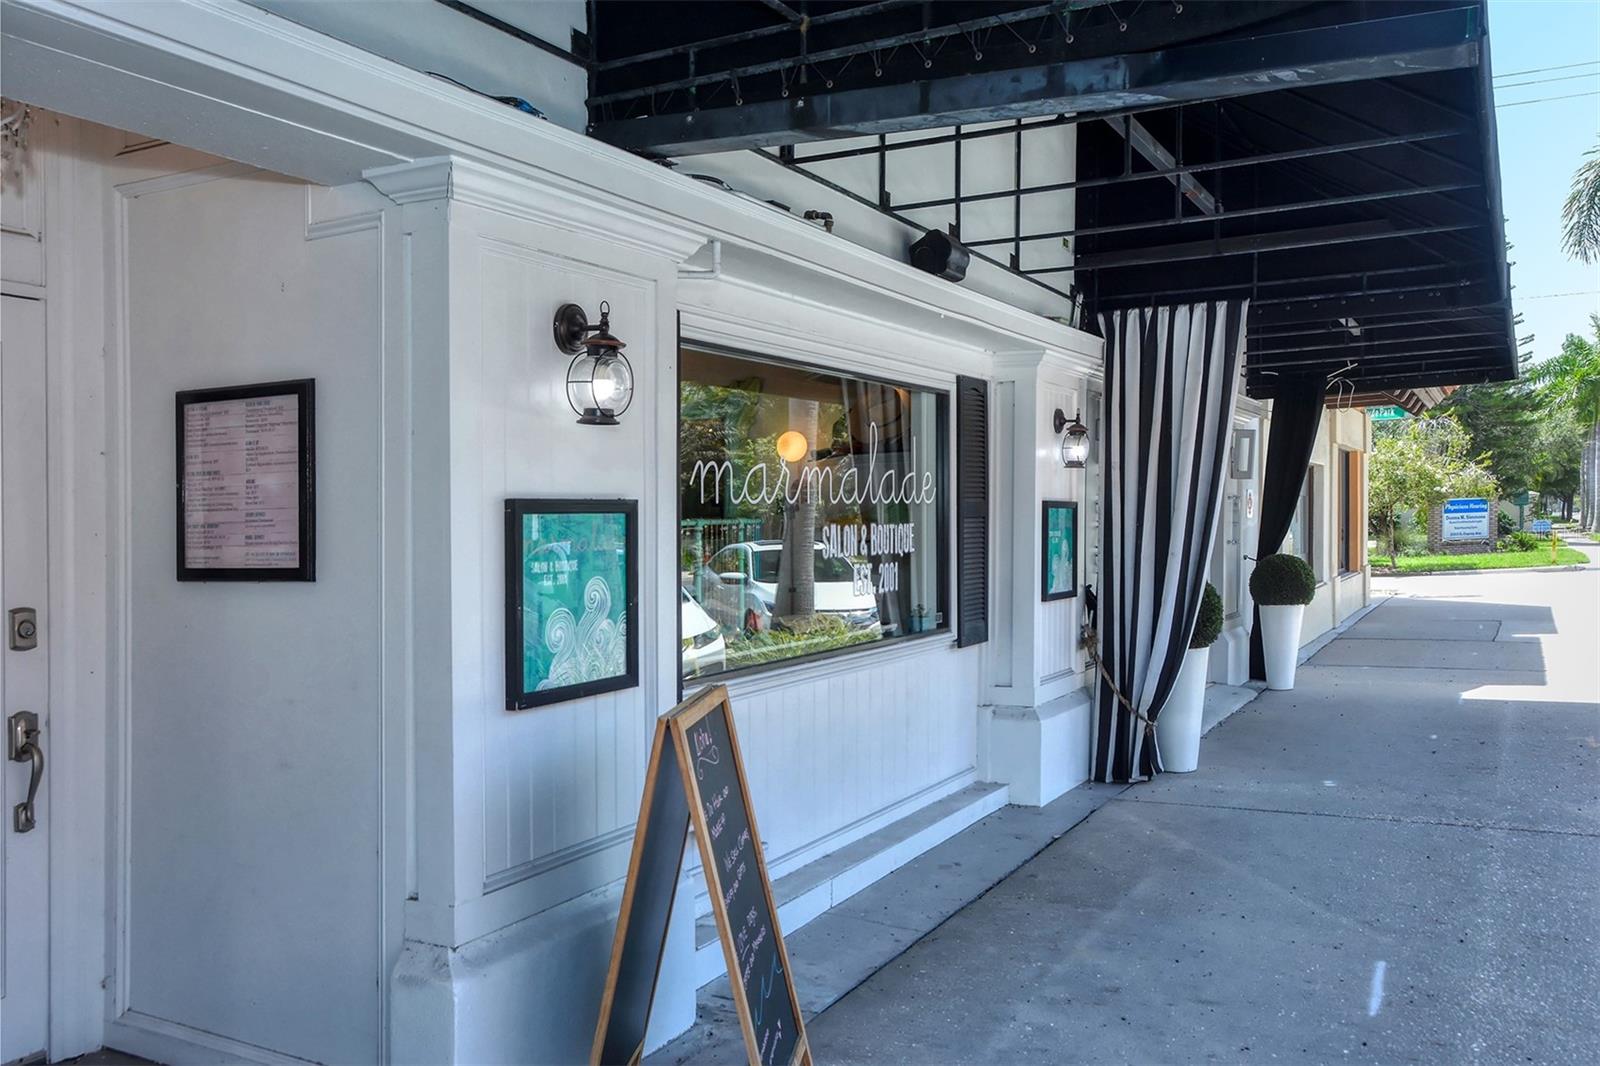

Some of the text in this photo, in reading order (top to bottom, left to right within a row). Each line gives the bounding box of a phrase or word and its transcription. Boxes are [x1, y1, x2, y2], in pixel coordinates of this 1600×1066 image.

[690, 421, 936, 505] marmalade
[822, 522, 915, 560] SALON & BOUTIQUE
[854, 561, 899, 597] EST. 2001
